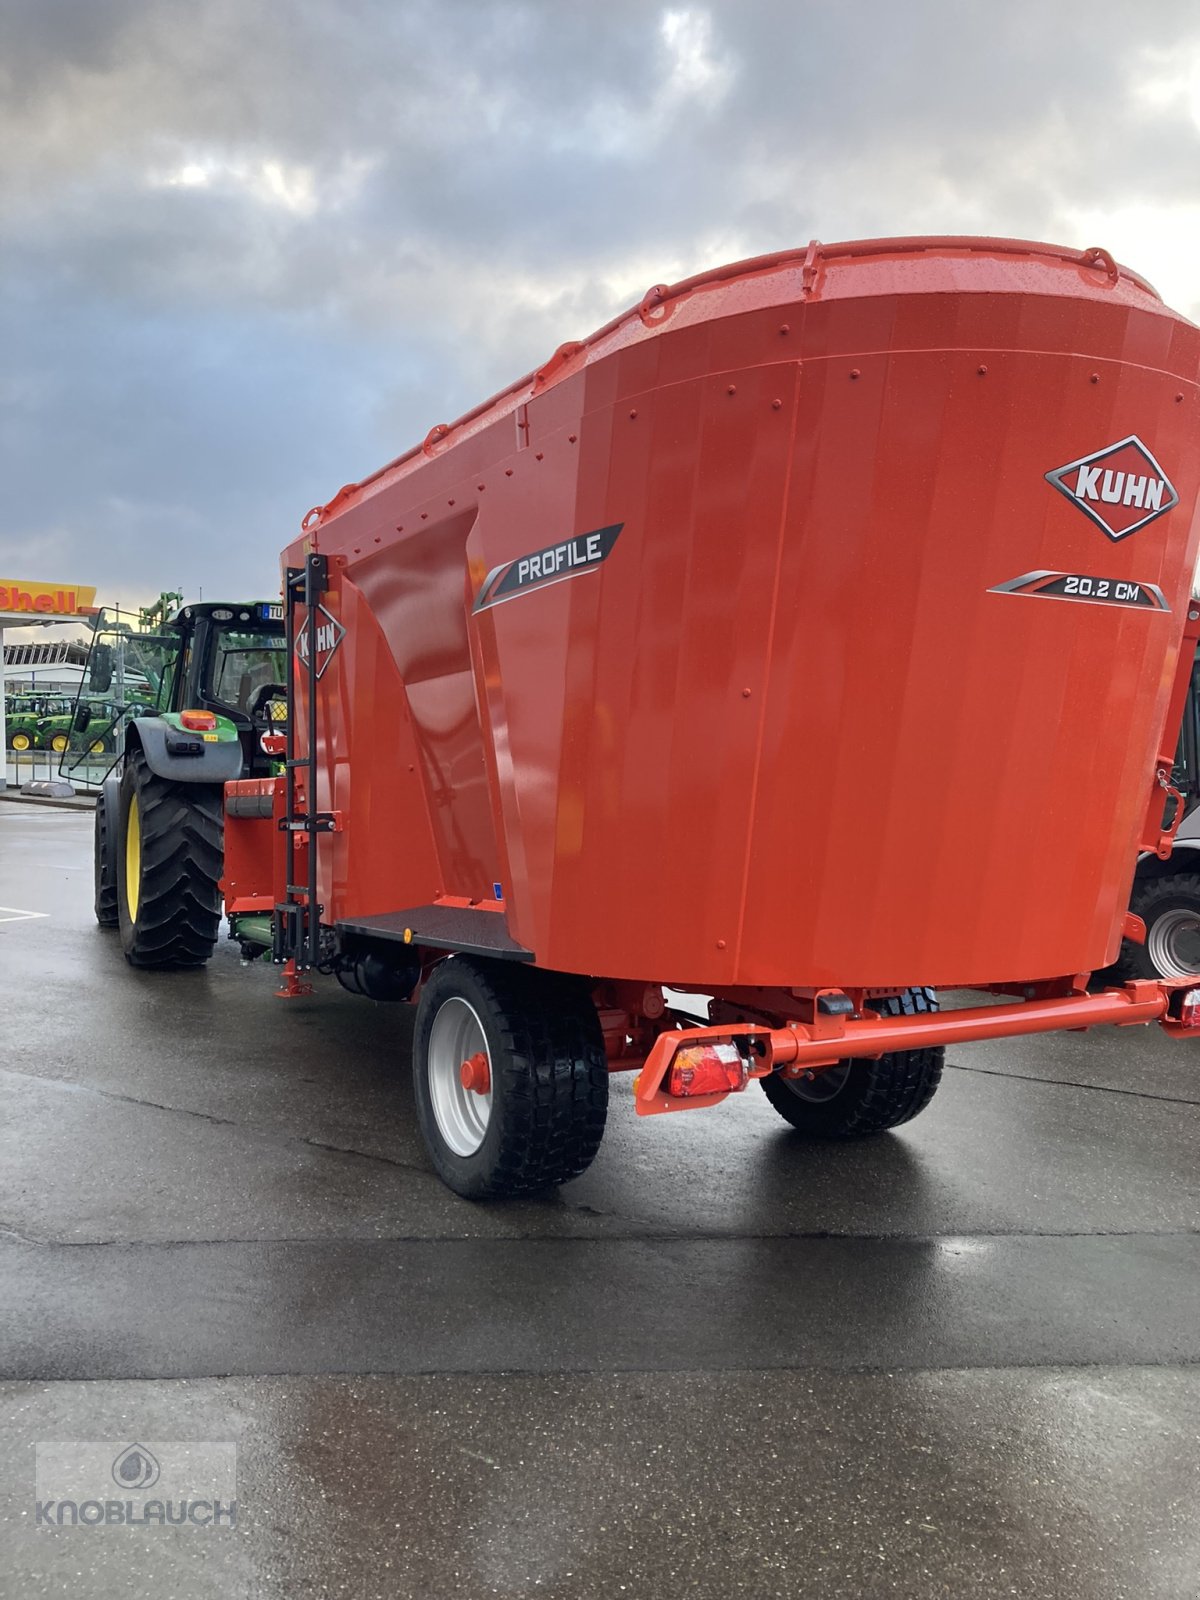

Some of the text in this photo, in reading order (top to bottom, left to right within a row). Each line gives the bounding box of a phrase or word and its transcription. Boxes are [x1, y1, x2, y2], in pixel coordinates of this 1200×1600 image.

[1075, 465, 1164, 511] KUHN
[519, 534, 601, 583] PROFILE
[1064, 577, 1139, 600] 20.2 CM
[301, 622, 335, 657] KHN
